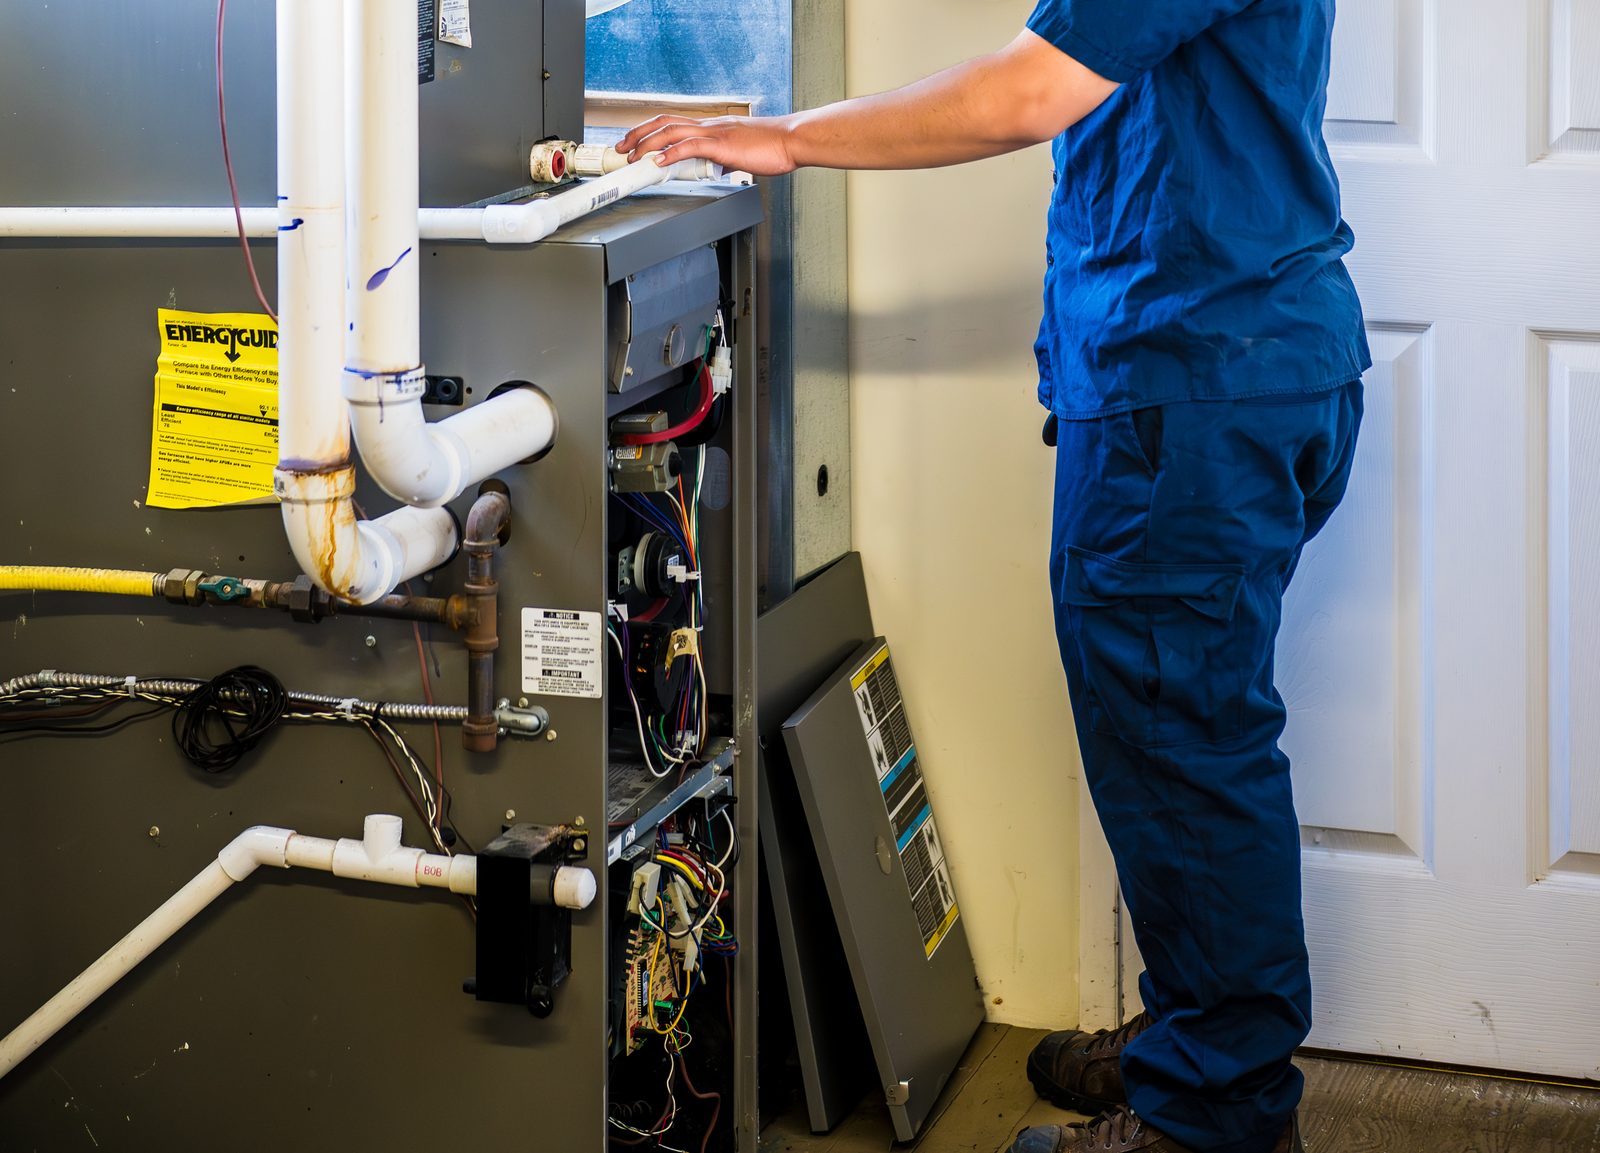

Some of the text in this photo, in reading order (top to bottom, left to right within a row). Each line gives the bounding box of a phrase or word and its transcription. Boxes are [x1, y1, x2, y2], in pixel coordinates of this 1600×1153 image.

[173, 361, 199, 369] Compare
[211, 364, 231, 373] Energy
[233, 367, 260, 376] Efficiency
[175, 368, 199, 376] Furnace
[213, 372, 232, 380] Others
[234, 374, 253, 382] Before
[204, 387, 226, 395] Efficiency
